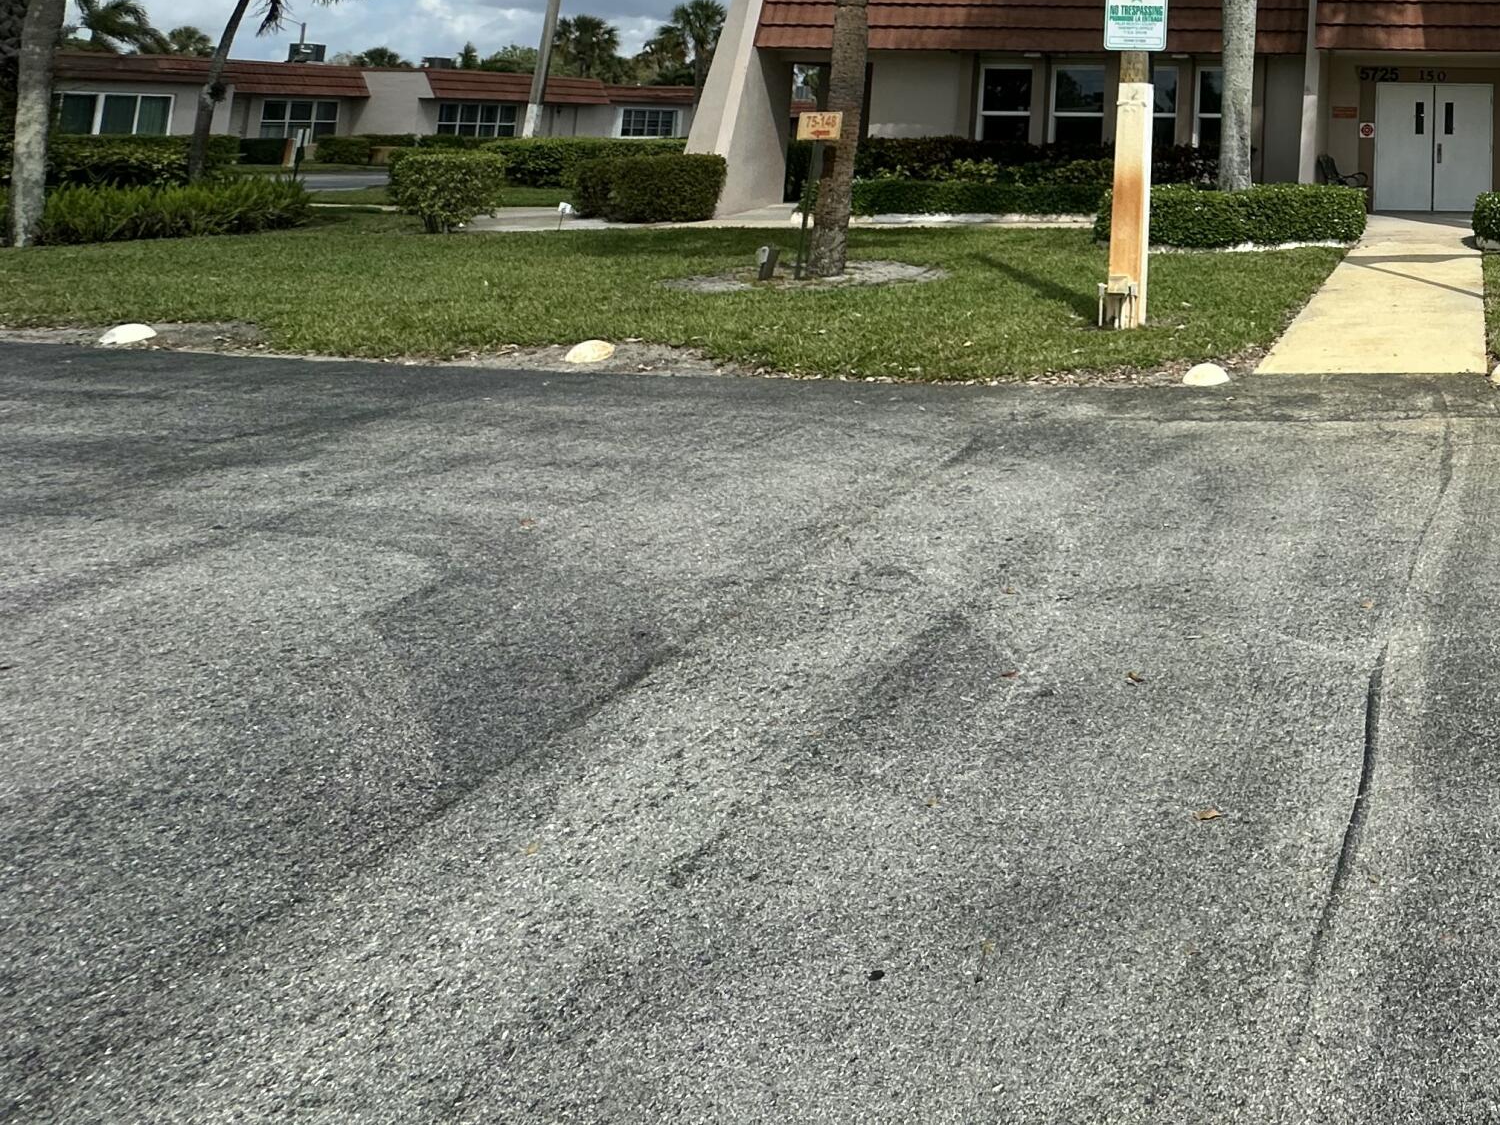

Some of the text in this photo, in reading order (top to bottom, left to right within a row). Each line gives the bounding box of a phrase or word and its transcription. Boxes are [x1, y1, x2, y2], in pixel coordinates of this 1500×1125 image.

[1109, 5, 1163, 16] NO TRESPASSING
[1360, 67, 1399, 82] 5725
[1420, 69, 1447, 82] 150
